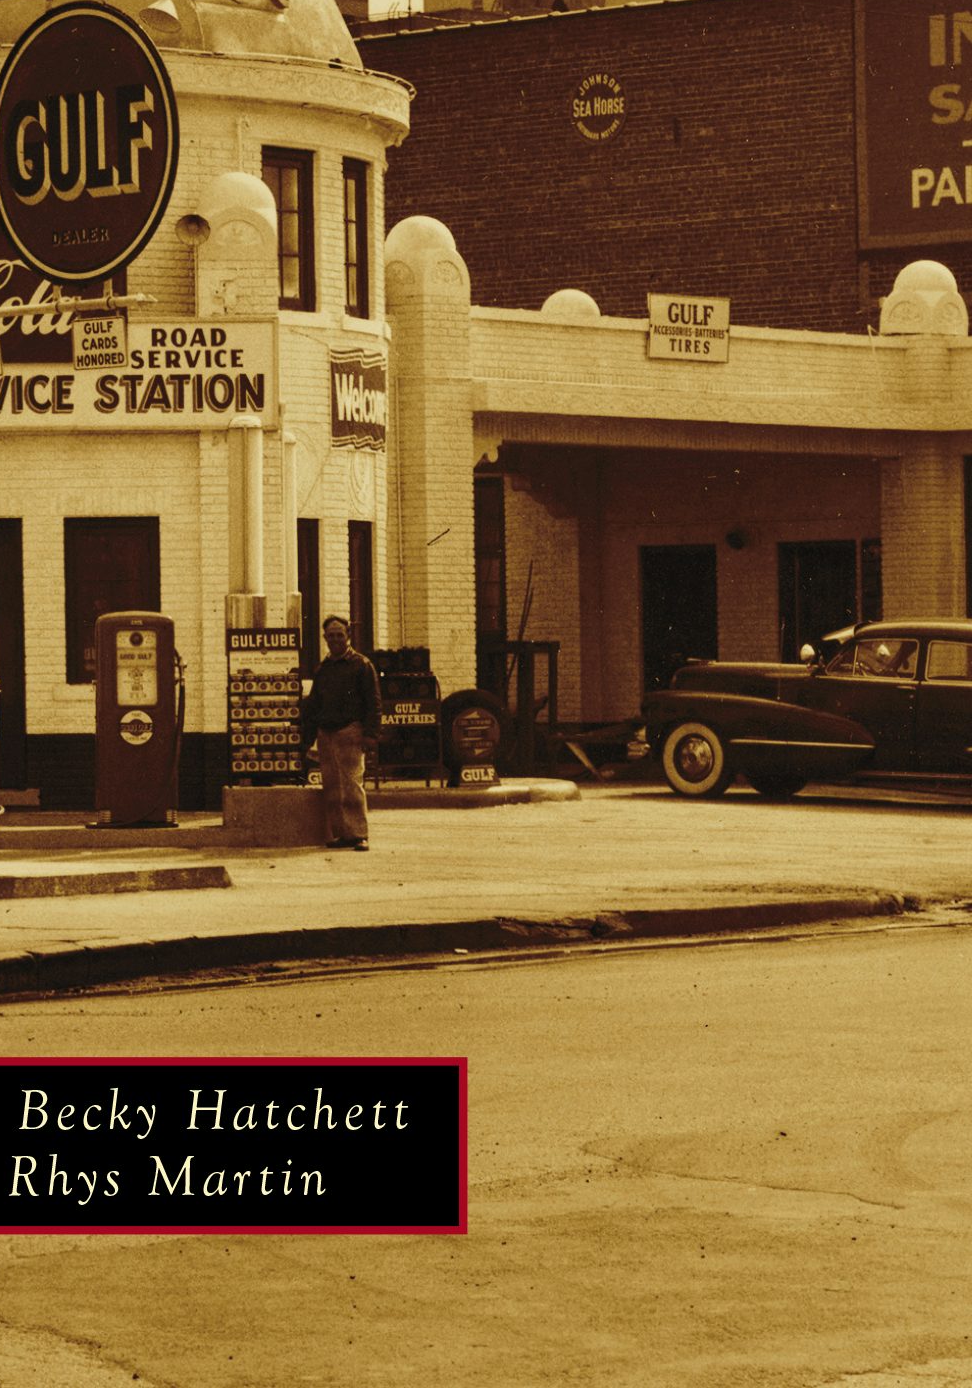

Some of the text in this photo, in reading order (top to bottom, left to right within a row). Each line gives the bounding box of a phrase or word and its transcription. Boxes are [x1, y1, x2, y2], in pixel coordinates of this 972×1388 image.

[579, 74, 621, 96] JOHNSON
[573, 96, 625, 118] SEA HORSE
[7, 84, 155, 205] GULF
[52, 228, 111, 247] DEALER
[668, 302, 714, 325] GULF
[84, 321, 114, 334] GULF
[81, 337, 118, 350] CARDS
[151, 328, 227, 347] ROAD
[669, 339, 710, 354] TIRES
[76, 352, 125, 367] HONORED
[130, 349, 245, 369] SERVICE
[94, 373, 265, 413] STATION
[231, 634, 296, 648] GULFLUBE
[395, 702, 421, 714] GULF
[381, 714, 436, 725] BATTERIES
[461, 768, 495, 782] GULF
